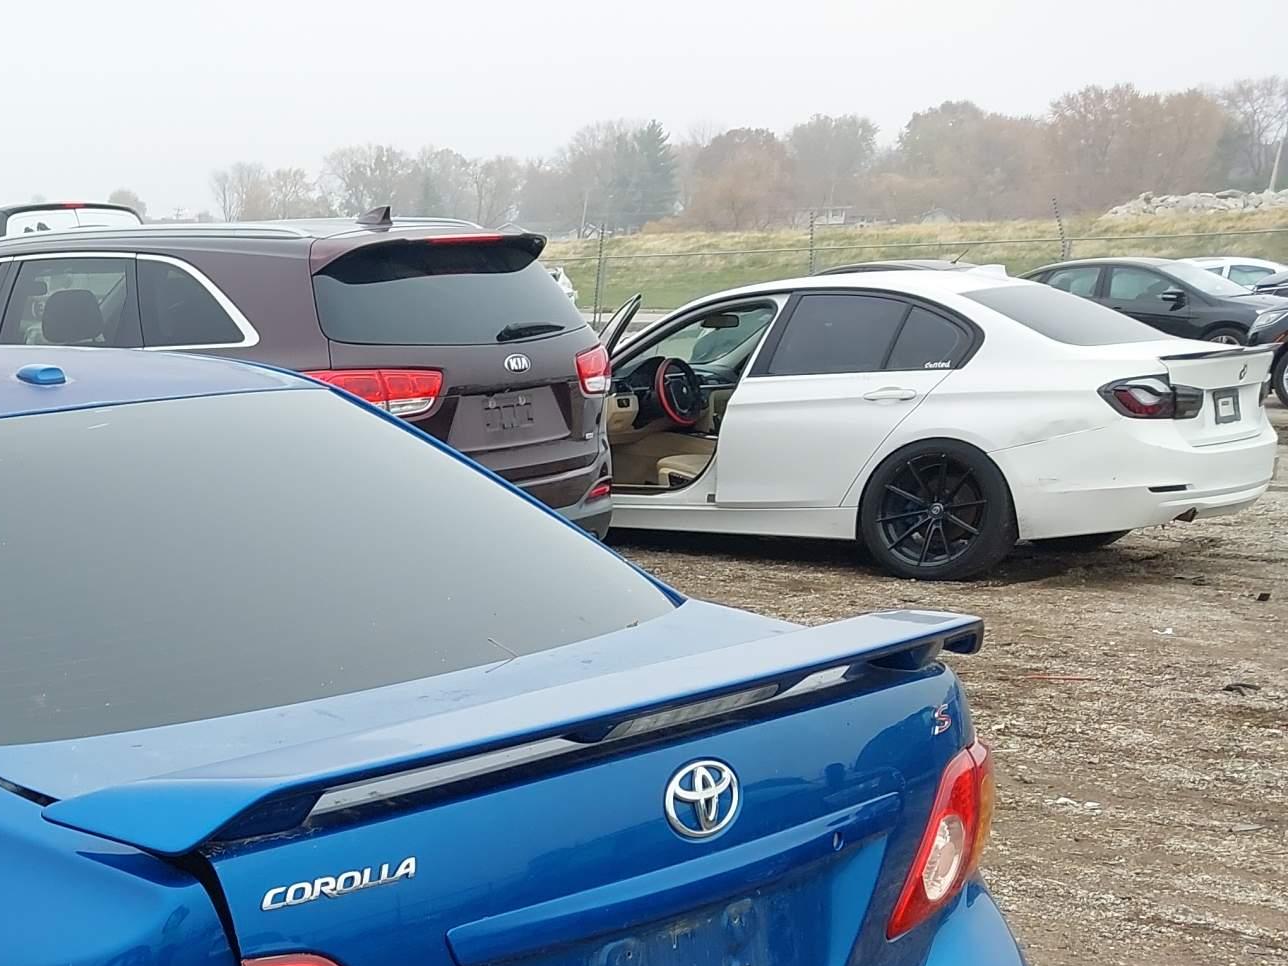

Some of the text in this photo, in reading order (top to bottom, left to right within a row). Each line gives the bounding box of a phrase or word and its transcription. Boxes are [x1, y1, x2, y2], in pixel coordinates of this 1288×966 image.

[509, 357, 529, 370] KIA
[934, 703, 952, 736] S
[262, 856, 416, 911] COROLLA
